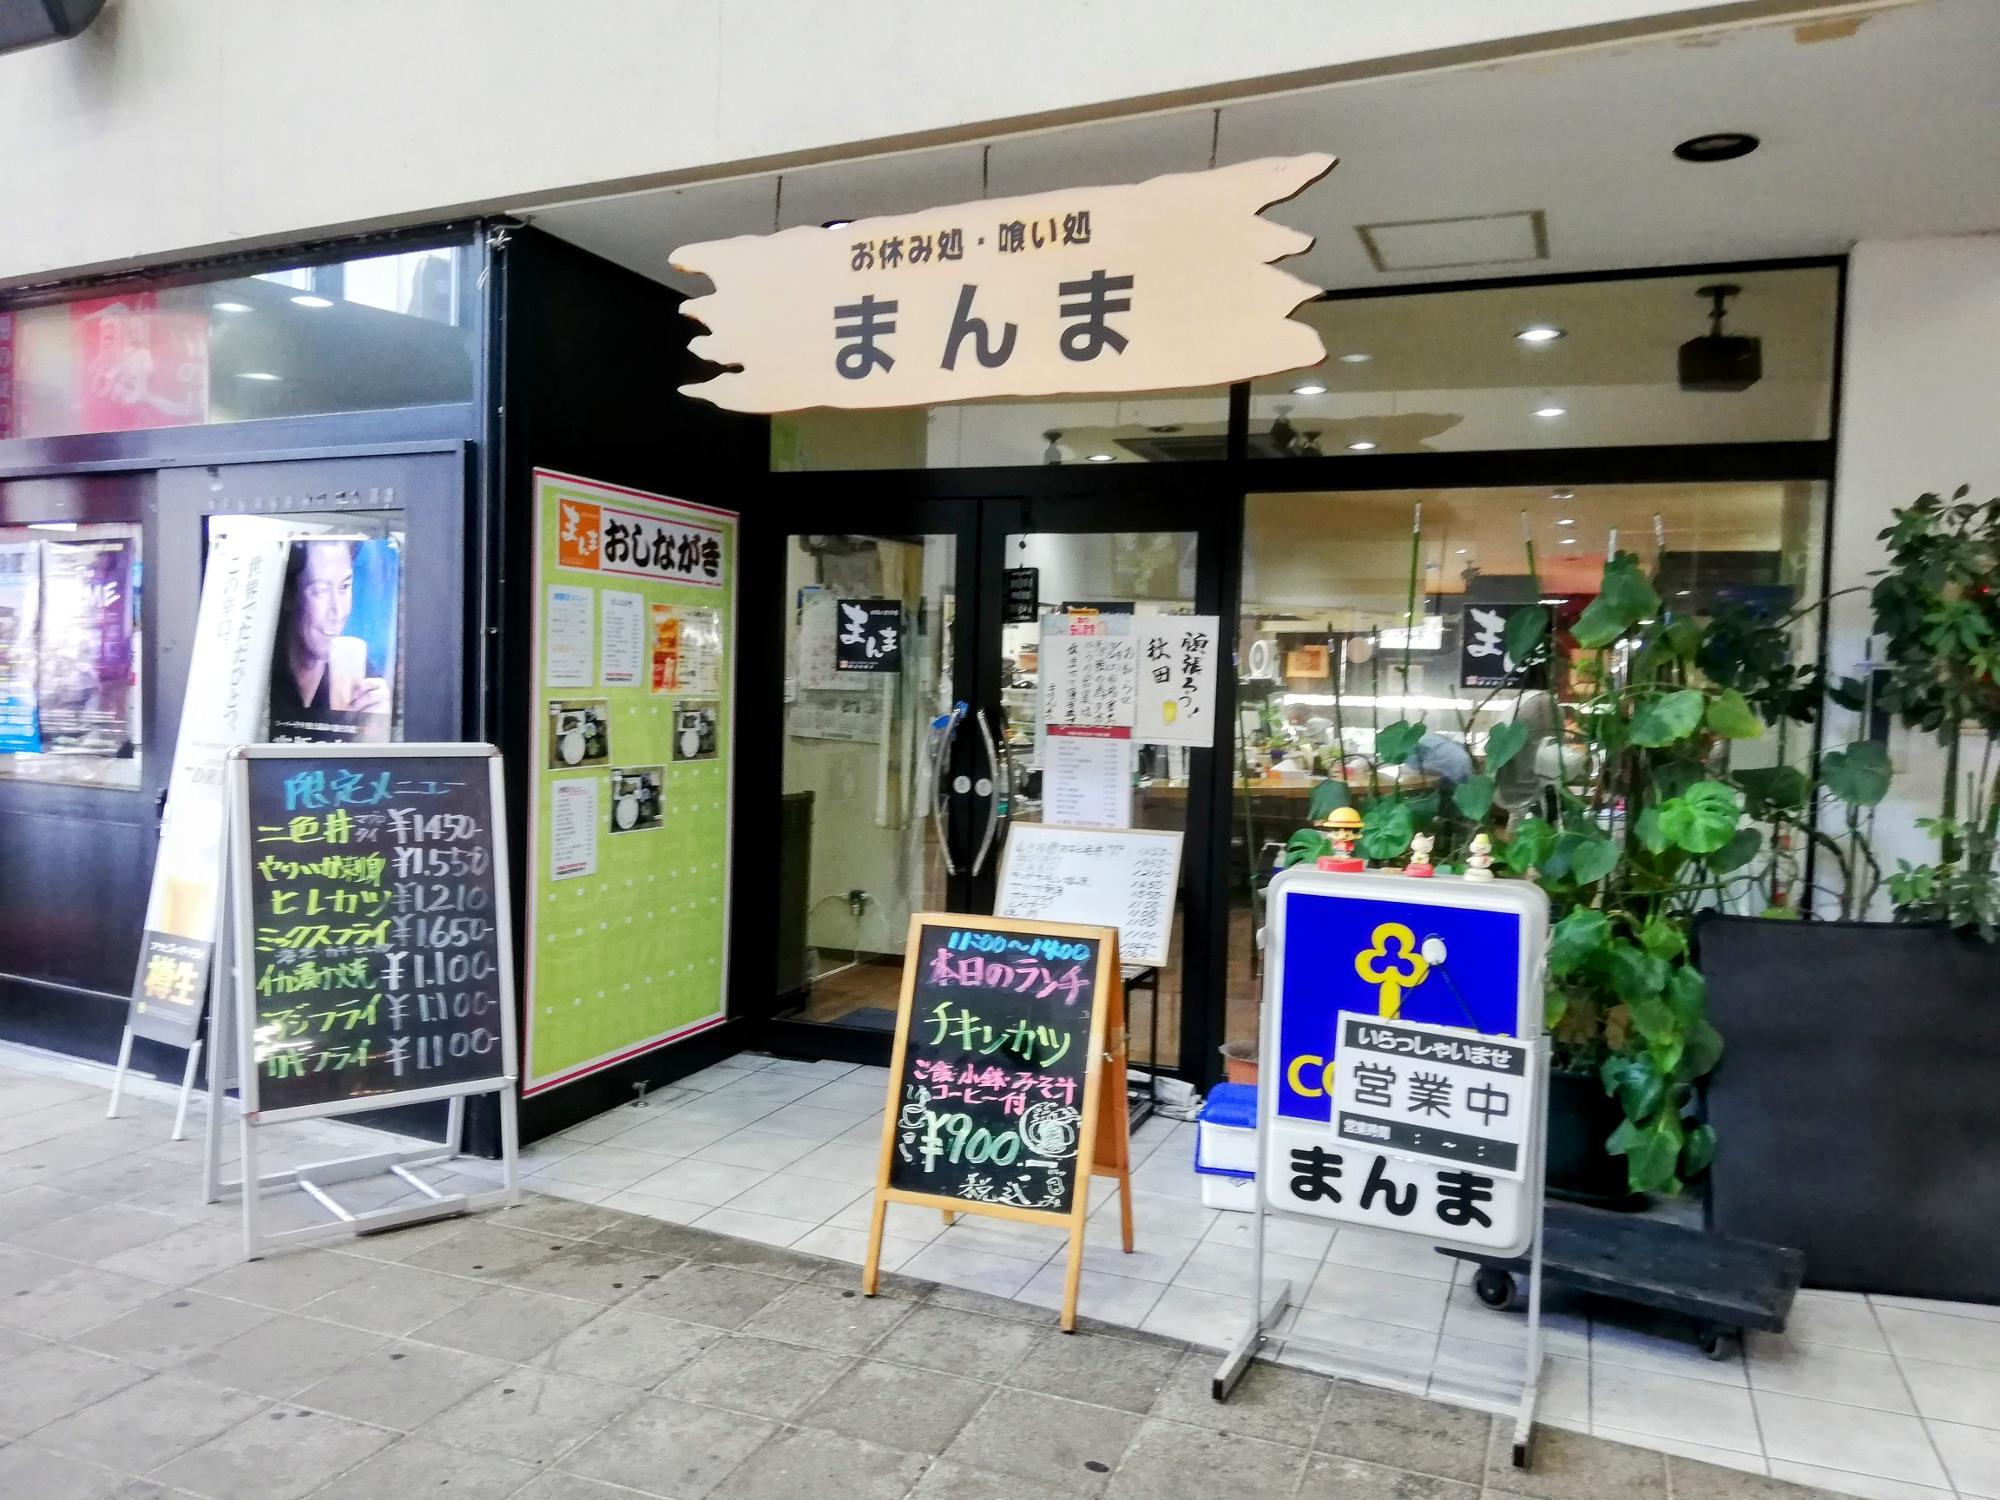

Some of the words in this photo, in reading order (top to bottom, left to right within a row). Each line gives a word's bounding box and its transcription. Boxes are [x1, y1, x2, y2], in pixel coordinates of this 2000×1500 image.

[850, 210, 1092, 272] お休み処・喰い処
[832, 269, 1134, 380] まんま
[604, 518, 721, 578] おしながき
[839, 602, 899, 659] まんま
[284, 768, 467, 811] 限定メニュー
[270, 888, 392, 918] ヒレカツ
[928, 948, 1091, 1006] 本日のランチ
[923, 1001, 1072, 1068] チキンカツ
[1357, 1026, 1513, 1069] いらっしゃいませ
[930, 1084, 1028, 1116] コーヒー付
[1353, 1060, 1510, 1128] 営業中
[1290, 1145, 1494, 1229] まんま
